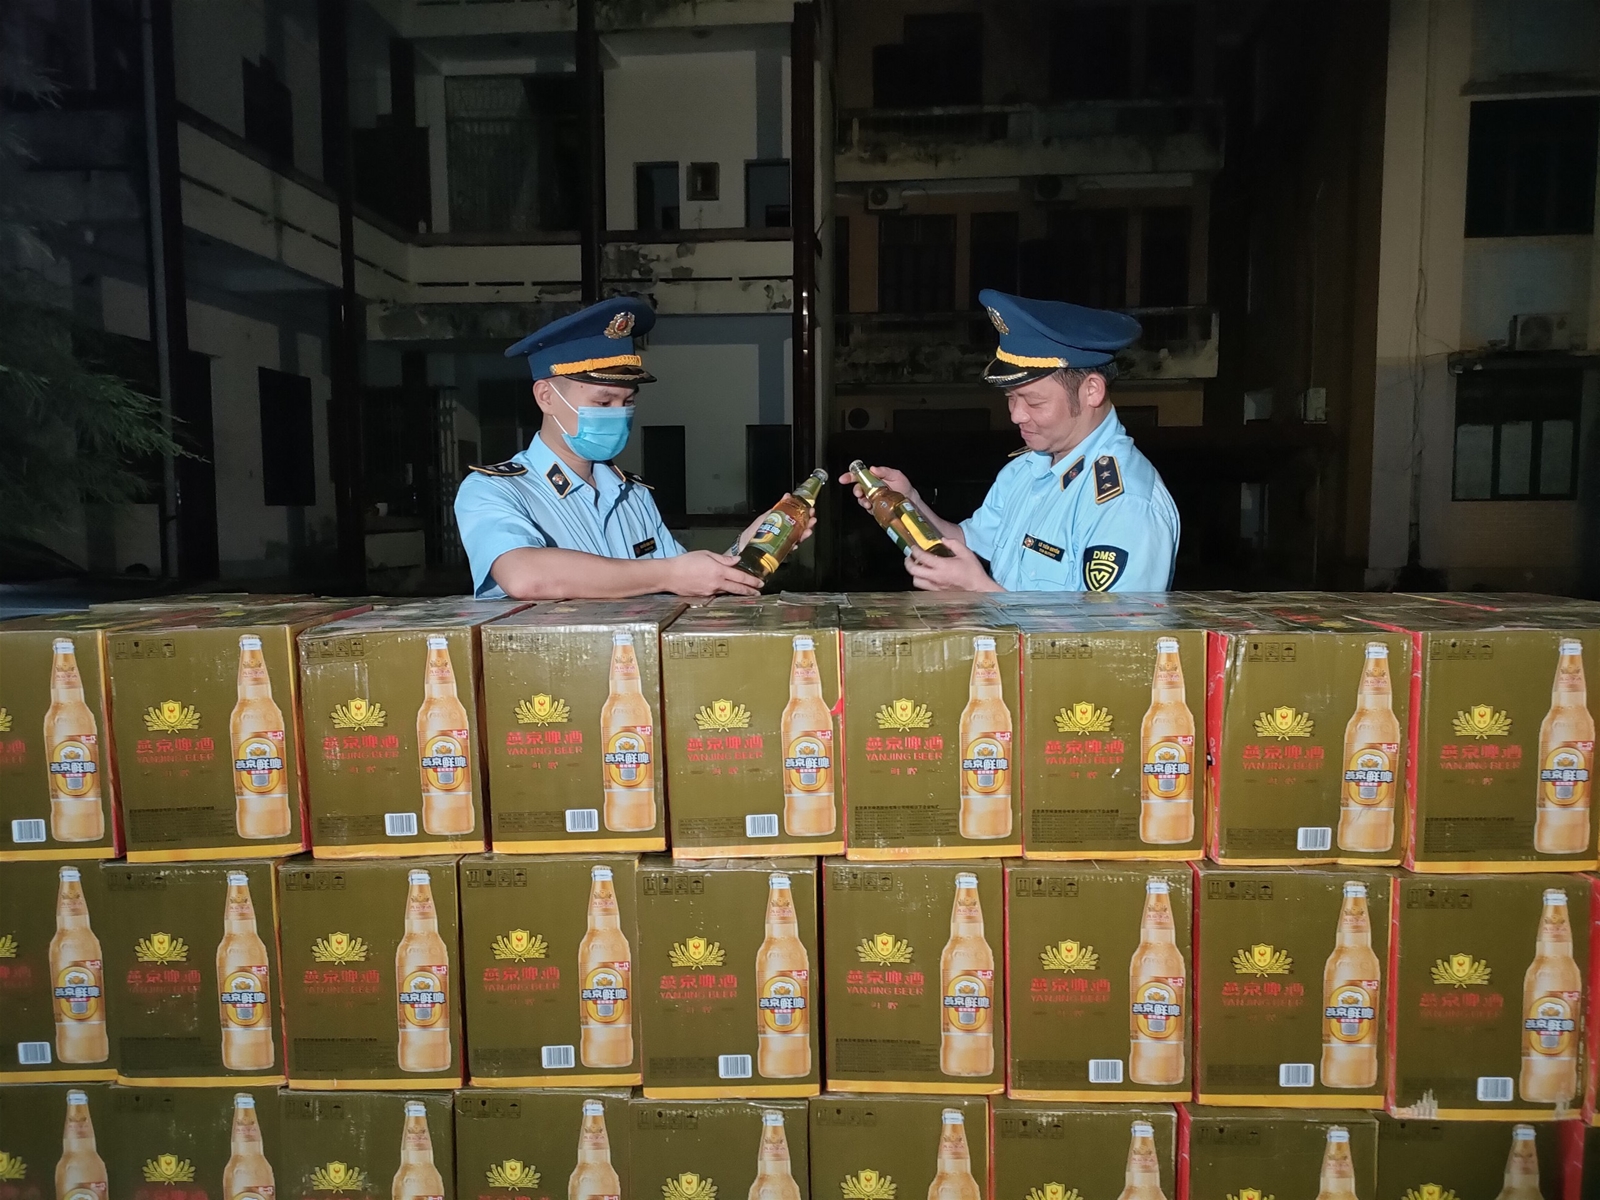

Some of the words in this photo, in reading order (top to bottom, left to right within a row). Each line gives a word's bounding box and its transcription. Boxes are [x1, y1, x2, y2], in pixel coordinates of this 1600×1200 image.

[1093, 550, 1117, 562] DMS
[506, 729, 582, 746] 燕京啤酒
[687, 735, 763, 751] 燕京啤酒
[866, 735, 943, 751] 燕京啤酒
[506, 746, 551, 755] YANJING
[553, 745, 582, 754] BEER
[1045, 738, 1124, 755] 燕京啤酒
[1243, 744, 1324, 761] 燕京啤酒
[1441, 743, 1522, 760] 燕京啤酒
[687, 751, 732, 761] YANJING
[734, 750, 763, 760] BEER
[866, 751, 911, 761] YANJING
[914, 750, 943, 760] BEER
[1045, 755, 1092, 764] YANJING
[1094, 754, 1124, 763] BEER
[1243, 761, 1291, 770] YANJING
[1293, 760, 1324, 769] BEER
[483, 966, 559, 982] 燕京啤酒
[659, 973, 737, 989] 燕京啤酒
[846, 969, 924, 985] 燕京啤酒
[846, 985, 892, 995] YANJING
[894, 984, 924, 994] BEER
[1030, 977, 1110, 993] 燕京啤酒
[1221, 981, 1303, 997] 燕京啤酒
[659, 989, 705, 999] YANJING
[707, 988, 737, 998] BEER
